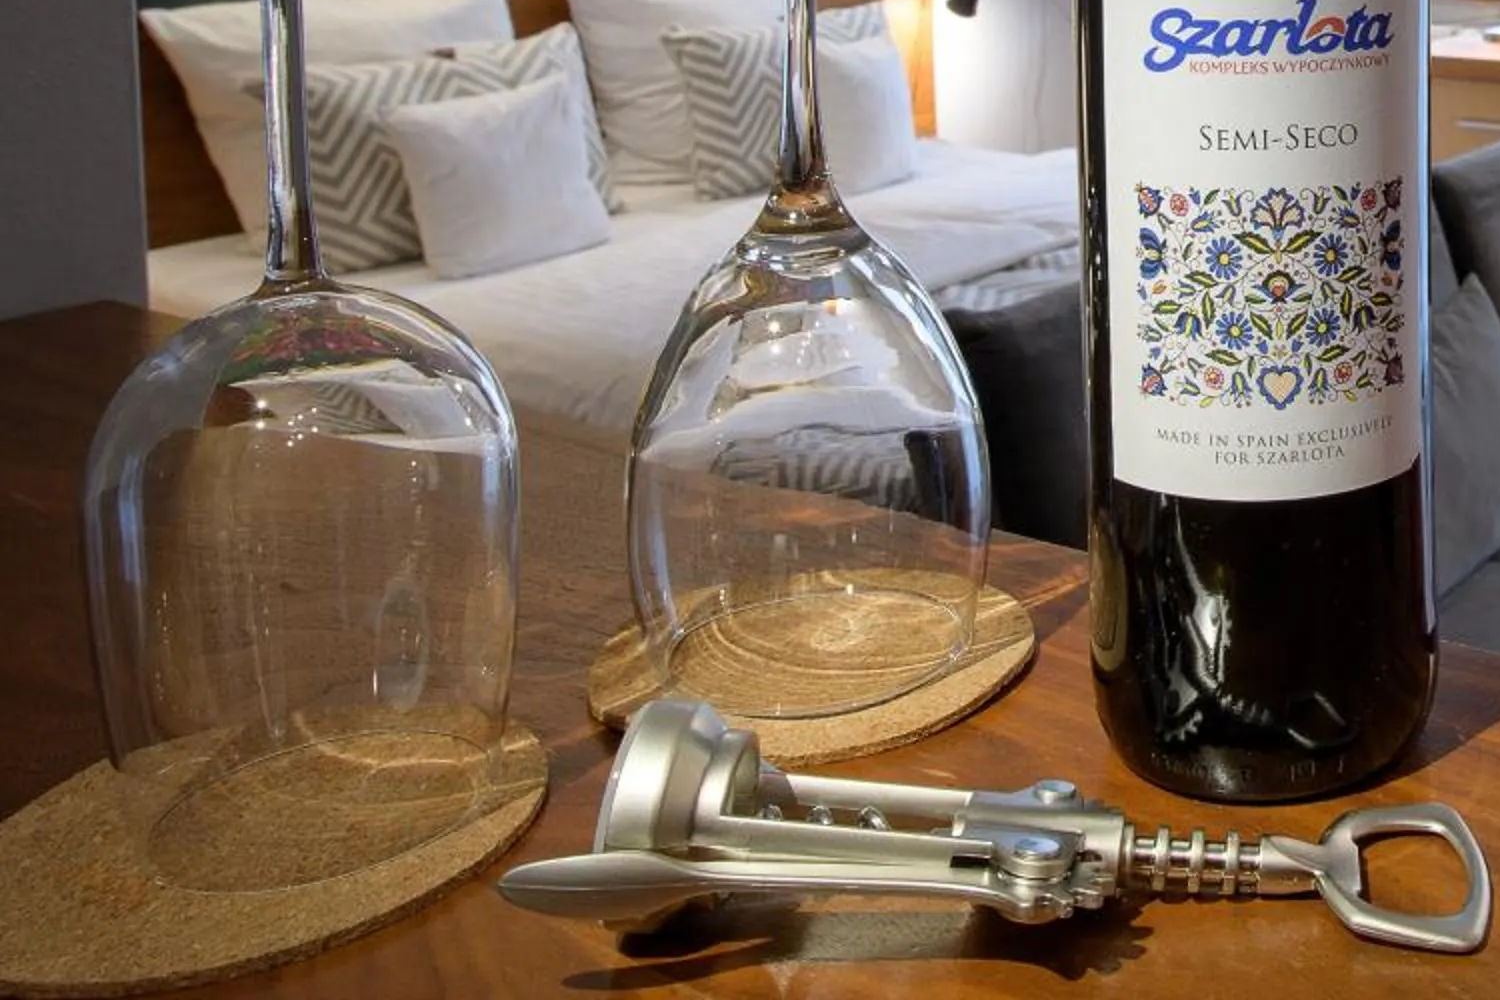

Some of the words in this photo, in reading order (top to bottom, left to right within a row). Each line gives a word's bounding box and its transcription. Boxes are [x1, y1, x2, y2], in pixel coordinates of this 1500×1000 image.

[1189, 58, 1269, 75] KOMPLEKS
[1272, 53, 1391, 74] WYPOCZYNKOWY
[1156, 427, 1200, 445] MADE
[1209, 432, 1229, 447] IN
[1237, 432, 1288, 448] SPAIN
[1298, 415, 1393, 445] EXCLUSIVELY
[1215, 451, 1250, 465] FOR
[1256, 445, 1345, 465] SZARLOTA
